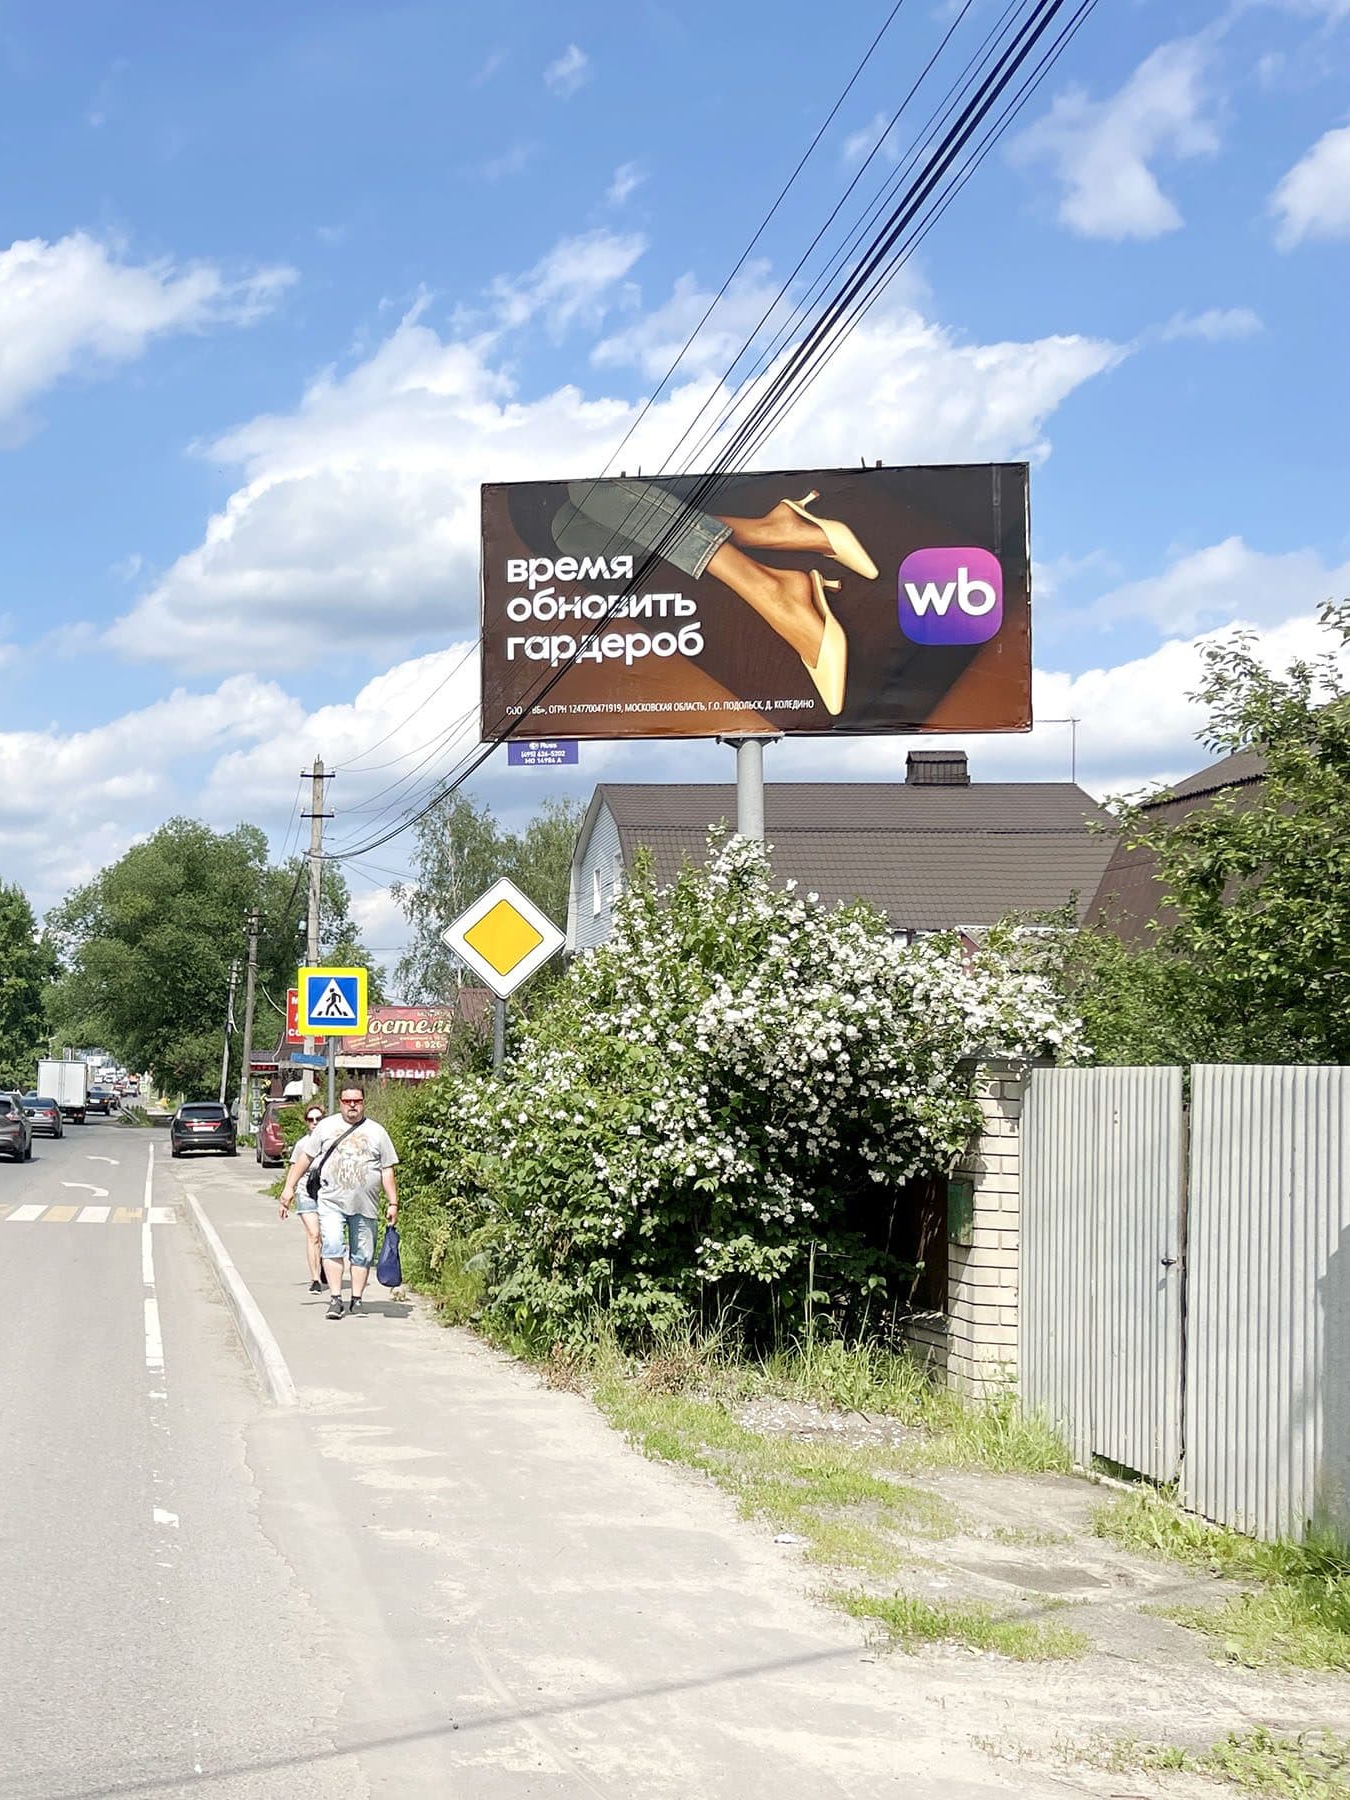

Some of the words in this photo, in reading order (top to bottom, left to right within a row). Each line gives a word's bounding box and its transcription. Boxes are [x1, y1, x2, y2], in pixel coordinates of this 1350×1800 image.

[507, 555, 634, 590] время
[507, 587, 697, 622] обновить
[904, 567, 996, 616] wb
[507, 622, 704, 667] гардероб
[549, 704, 567, 714] ОГРН
[569, 703, 624, 715] 1247700471919,
[625, 702, 672, 714] МОСКОВСКАЯ
[674, 701, 707, 712] ОБЛАСТЬ,
[708, 701, 722, 711] Г.О.
[724, 700, 764, 711] ПОДОЛЬСК,
[765, 700, 773, 711] Д.
[775, 699, 815, 710] КОЛЕДИНО
